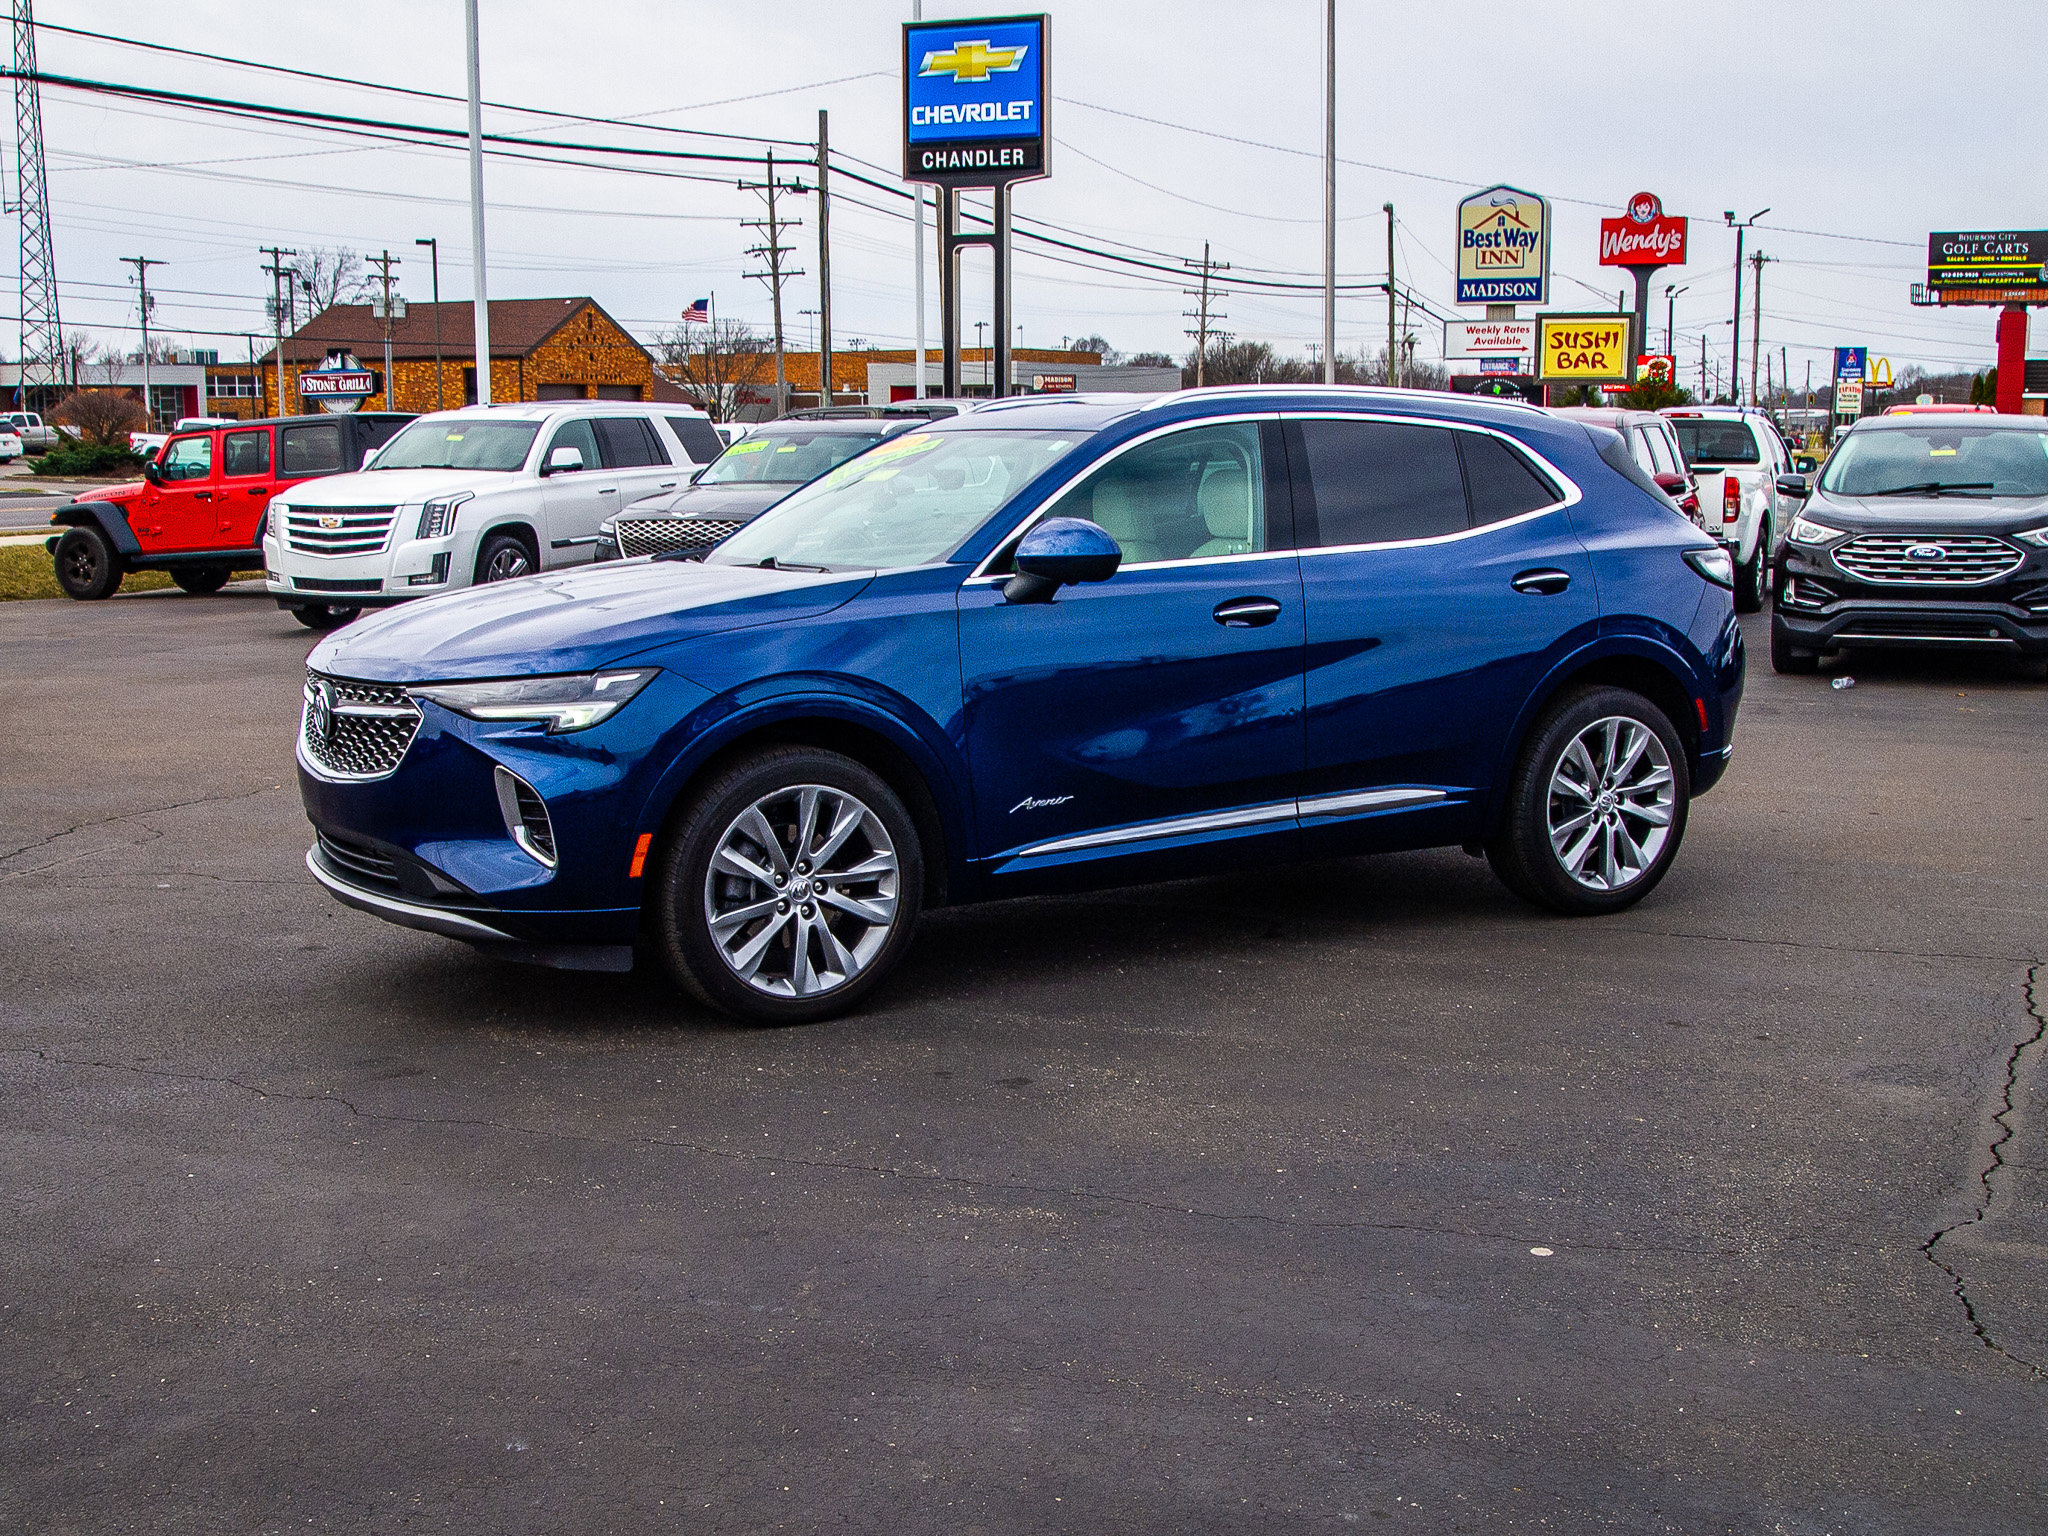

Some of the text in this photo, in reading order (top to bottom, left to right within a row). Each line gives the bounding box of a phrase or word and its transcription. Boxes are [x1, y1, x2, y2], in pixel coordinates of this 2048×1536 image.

[912, 100, 1034, 125] CHEVROLET
[922, 148, 1024, 169] CHANDLER
[1463, 227, 1539, 253] Best Way
[1602, 223, 1682, 259] Wendy's
[1480, 249, 1521, 265] INN
[1462, 282, 1537, 298] MADISON
[1466, 325, 1530, 336] Weekly Rates
[1473, 336, 1521, 345] Available
[1550, 331, 1619, 349] SUSHI
[1557, 352, 1609, 370] BAR
[338, 375, 367, 391] GRILL
